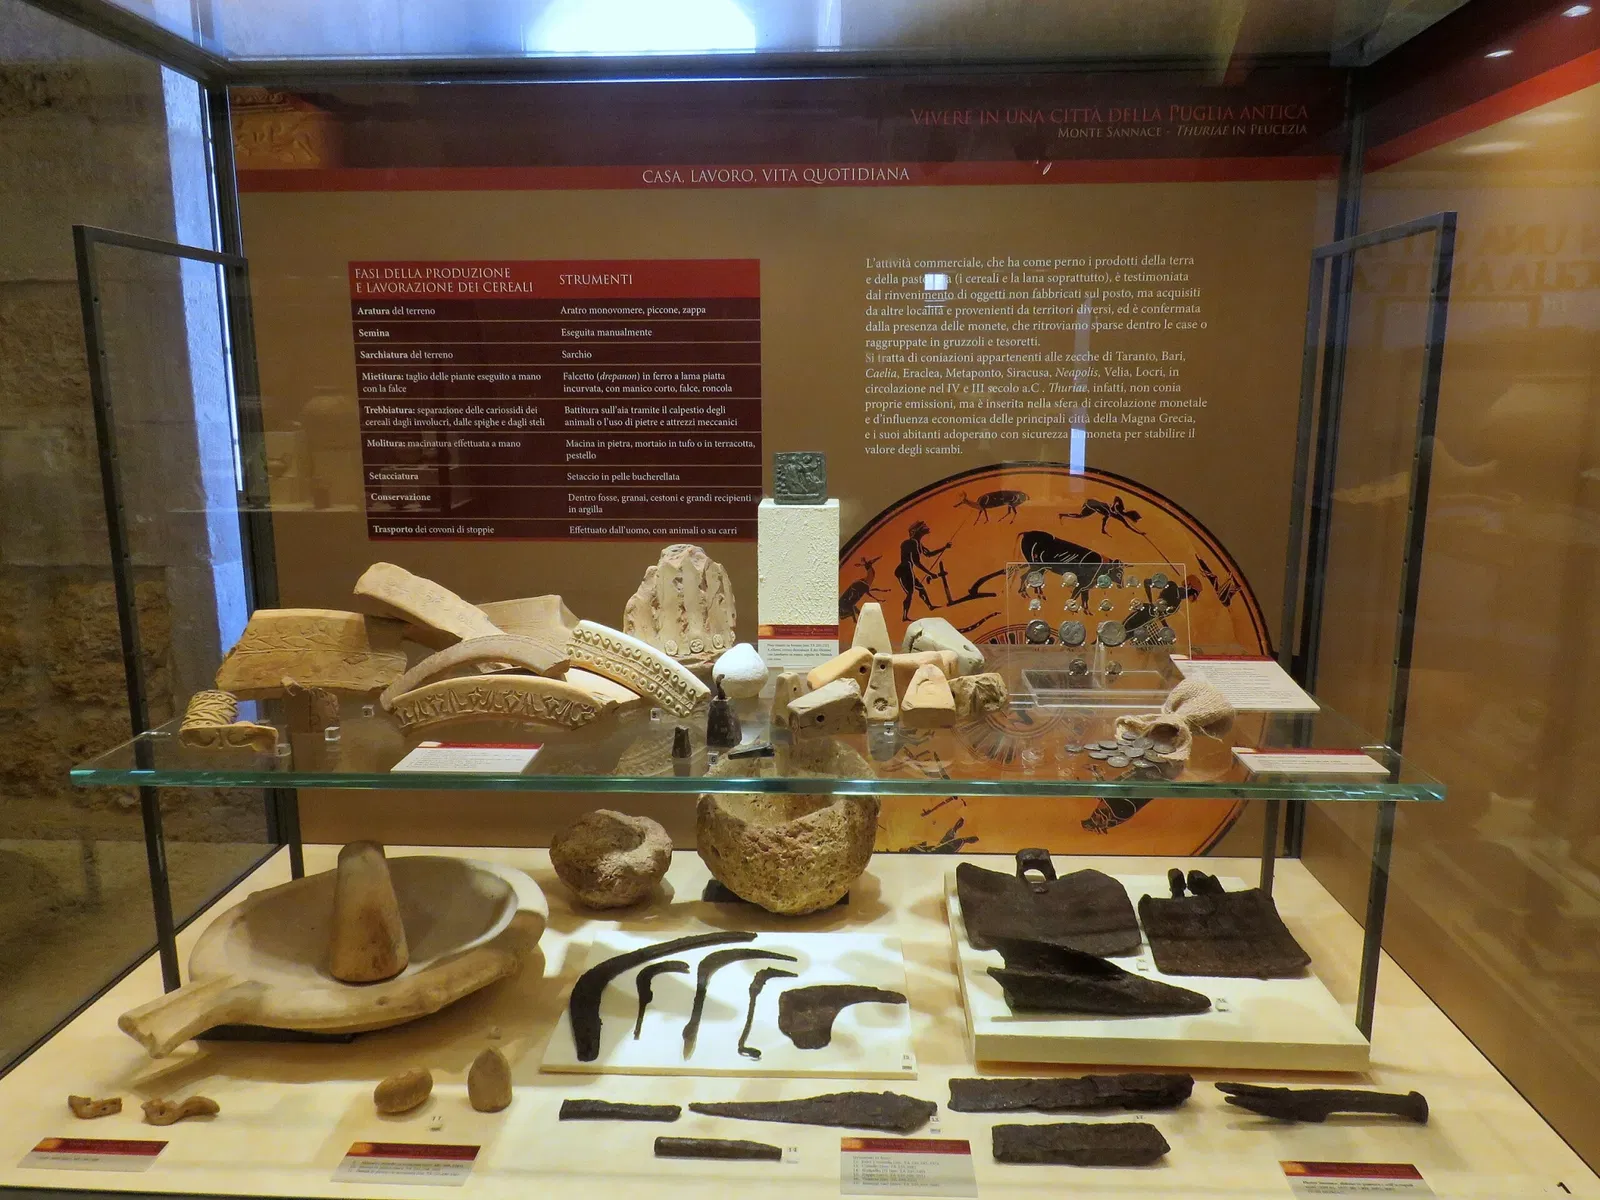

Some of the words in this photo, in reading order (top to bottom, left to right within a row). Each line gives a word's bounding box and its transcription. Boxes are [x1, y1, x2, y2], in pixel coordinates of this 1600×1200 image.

[910, 109, 973, 124] VIVERE
[979, 109, 1000, 123] IN
[1004, 108, 1044, 123] UNA
[1048, 105, 1101, 122] CITTÀ
[1108, 107, 1162, 122] DELLA
[1168, 106, 1235, 121] PUGLIA
[1238, 106, 1309, 120] ANTICA
[1057, 127, 1101, 137] MONTE
[1106, 126, 1161, 136] SANNACE
[1177, 125, 1227, 136] THURIAE
[1232, 125, 1245, 135] IN
[1250, 124, 1307, 135] PEUCEZIA
[642, 170, 685, 184] CASA,
[691, 169, 757, 183] LAVORO,
[762, 168, 798, 181] VITA
[802, 168, 909, 182] QUOTIDIANA
[866, 258, 911, 268] L'attività
[913, 257, 984, 269] commerciale,
[986, 257, 1004, 267] che
[1007, 257, 1020, 267] ha
[1054, 259, 1085, 270] perno
[1088, 257, 1092, 266] i
[1095, 256, 1137, 269] prodotti
[1140, 256, 1165, 266] della
[1169, 256, 1194, 265] terra
[355, 268, 379, 278] FASI
[384, 268, 422, 278] DELLA
[426, 268, 510, 278] PRODUZIONE
[559, 274, 632, 284] STRUMENTI
[356, 282, 361, 292] E
[366, 282, 453, 292] LAVORAZIONE
[458, 282, 478, 292] DEI
[482, 282, 532, 292] CEREALI
[357, 306, 389, 314] Aratura
[391, 306, 404, 314] del
[560, 305, 587, 313] Aratro
[646, 306, 681, 316] piccone,
[682, 308, 706, 316] zappa
[358, 328, 389, 336] Semina
[561, 327, 594, 338] Eseguita
[596, 327, 652, 336] manualmente
[865, 337, 927, 350] raggruppate
[930, 337, 940, 346] in
[942, 336, 984, 349] gruzzoli
[996, 337, 1041, 346] tesoretti.
[360, 350, 408, 358] Sarchiatura
[409, 350, 422, 358] del
[561, 349, 592, 358] Sarchio
[362, 371, 404, 380] Mietitura:
[405, 371, 428, 382] taglio
[429, 371, 448, 380] delle
[450, 372, 475, 382] piante
[476, 372, 510, 382] eseguito
[563, 371, 594, 380] Falcetto
[596, 371, 640, 382] (drepanon)
[652, 371, 672, 380] ferro
[680, 371, 700, 380] lama
[702, 372, 725, 382] piatta
[865, 368, 900, 380] Caelia,
[902, 368, 943, 379] Eraclea,
[945, 368, 1004, 381] Metaponto,
[1006, 368, 1052, 379] Siracusa,
[1055, 367, 1101, 381] Neapolis,
[1104, 367, 1132, 379] Velia,
[1136, 367, 1166, 379] Locri,
[1168, 368, 1179, 377] in
[378, 384, 386, 392] la
[388, 384, 406, 392] falce
[563, 384, 604, 393] incurvata,
[653, 384, 678, 393] corto,
[679, 383, 701, 393] falce,
[702, 383, 732, 392] roncola
[865, 400, 902, 412] proprie
[904, 399, 956, 410] emissioni,
[977, 398, 983, 408] è
[986, 399, 1024, 408] inserita
[1027, 398, 1051, 408] nella
[1054, 398, 1078, 408] sfera
[1080, 398, 1091, 408] di
[1093, 398, 1156, 408] circolazione
[1159, 397, 1207, 407] monetale
[363, 405, 415, 413] Trebbiatura:
[416, 406, 463, 416] separazione
[464, 405, 484, 413] delle
[485, 405, 523, 413] cariossidi
[525, 405, 538, 413] dei
[564, 405, 599, 413] Battitura
[600, 405, 628, 413] sull'aia
[661, 405, 667, 413] il
[668, 405, 704, 416] calpestio
[705, 405, 725, 416] degli
[872, 414, 928, 424] d'influenza
[931, 415, 986, 424] economica
[989, 413, 1013, 423] delle
[1016, 413, 1065, 427] principali
[1068, 413, 1090, 423] città
[1093, 413, 1117, 423] della
[1120, 413, 1155, 426] Magna
[1158, 413, 1196, 425] Grecia,
[366, 438, 405, 446] Molitura:
[453, 438, 490, 446] effettuata
[566, 450, 596, 462] pestello
[864, 444, 895, 454] valore
[897, 444, 922, 457] degli
[925, 444, 963, 454] scambi.
[369, 471, 418, 479] Setacciatura
[566, 472, 600, 480] Setaccio
[611, 472, 630, 483] pelle
[631, 472, 680, 480] bucherellata
[370, 492, 430, 500] Conservazione
[567, 493, 596, 501] Dentro
[597, 493, 620, 503] fosse,
[621, 494, 649, 504] granai,
[686, 493, 712, 504] grandi
[714, 494, 751, 504] recipienti
[578, 504, 602, 515] argilla
[372, 525, 413, 536] Trasporto
[414, 525, 427, 533] dei
[456, 525, 464, 533] di
[466, 526, 494, 536] stoppie
